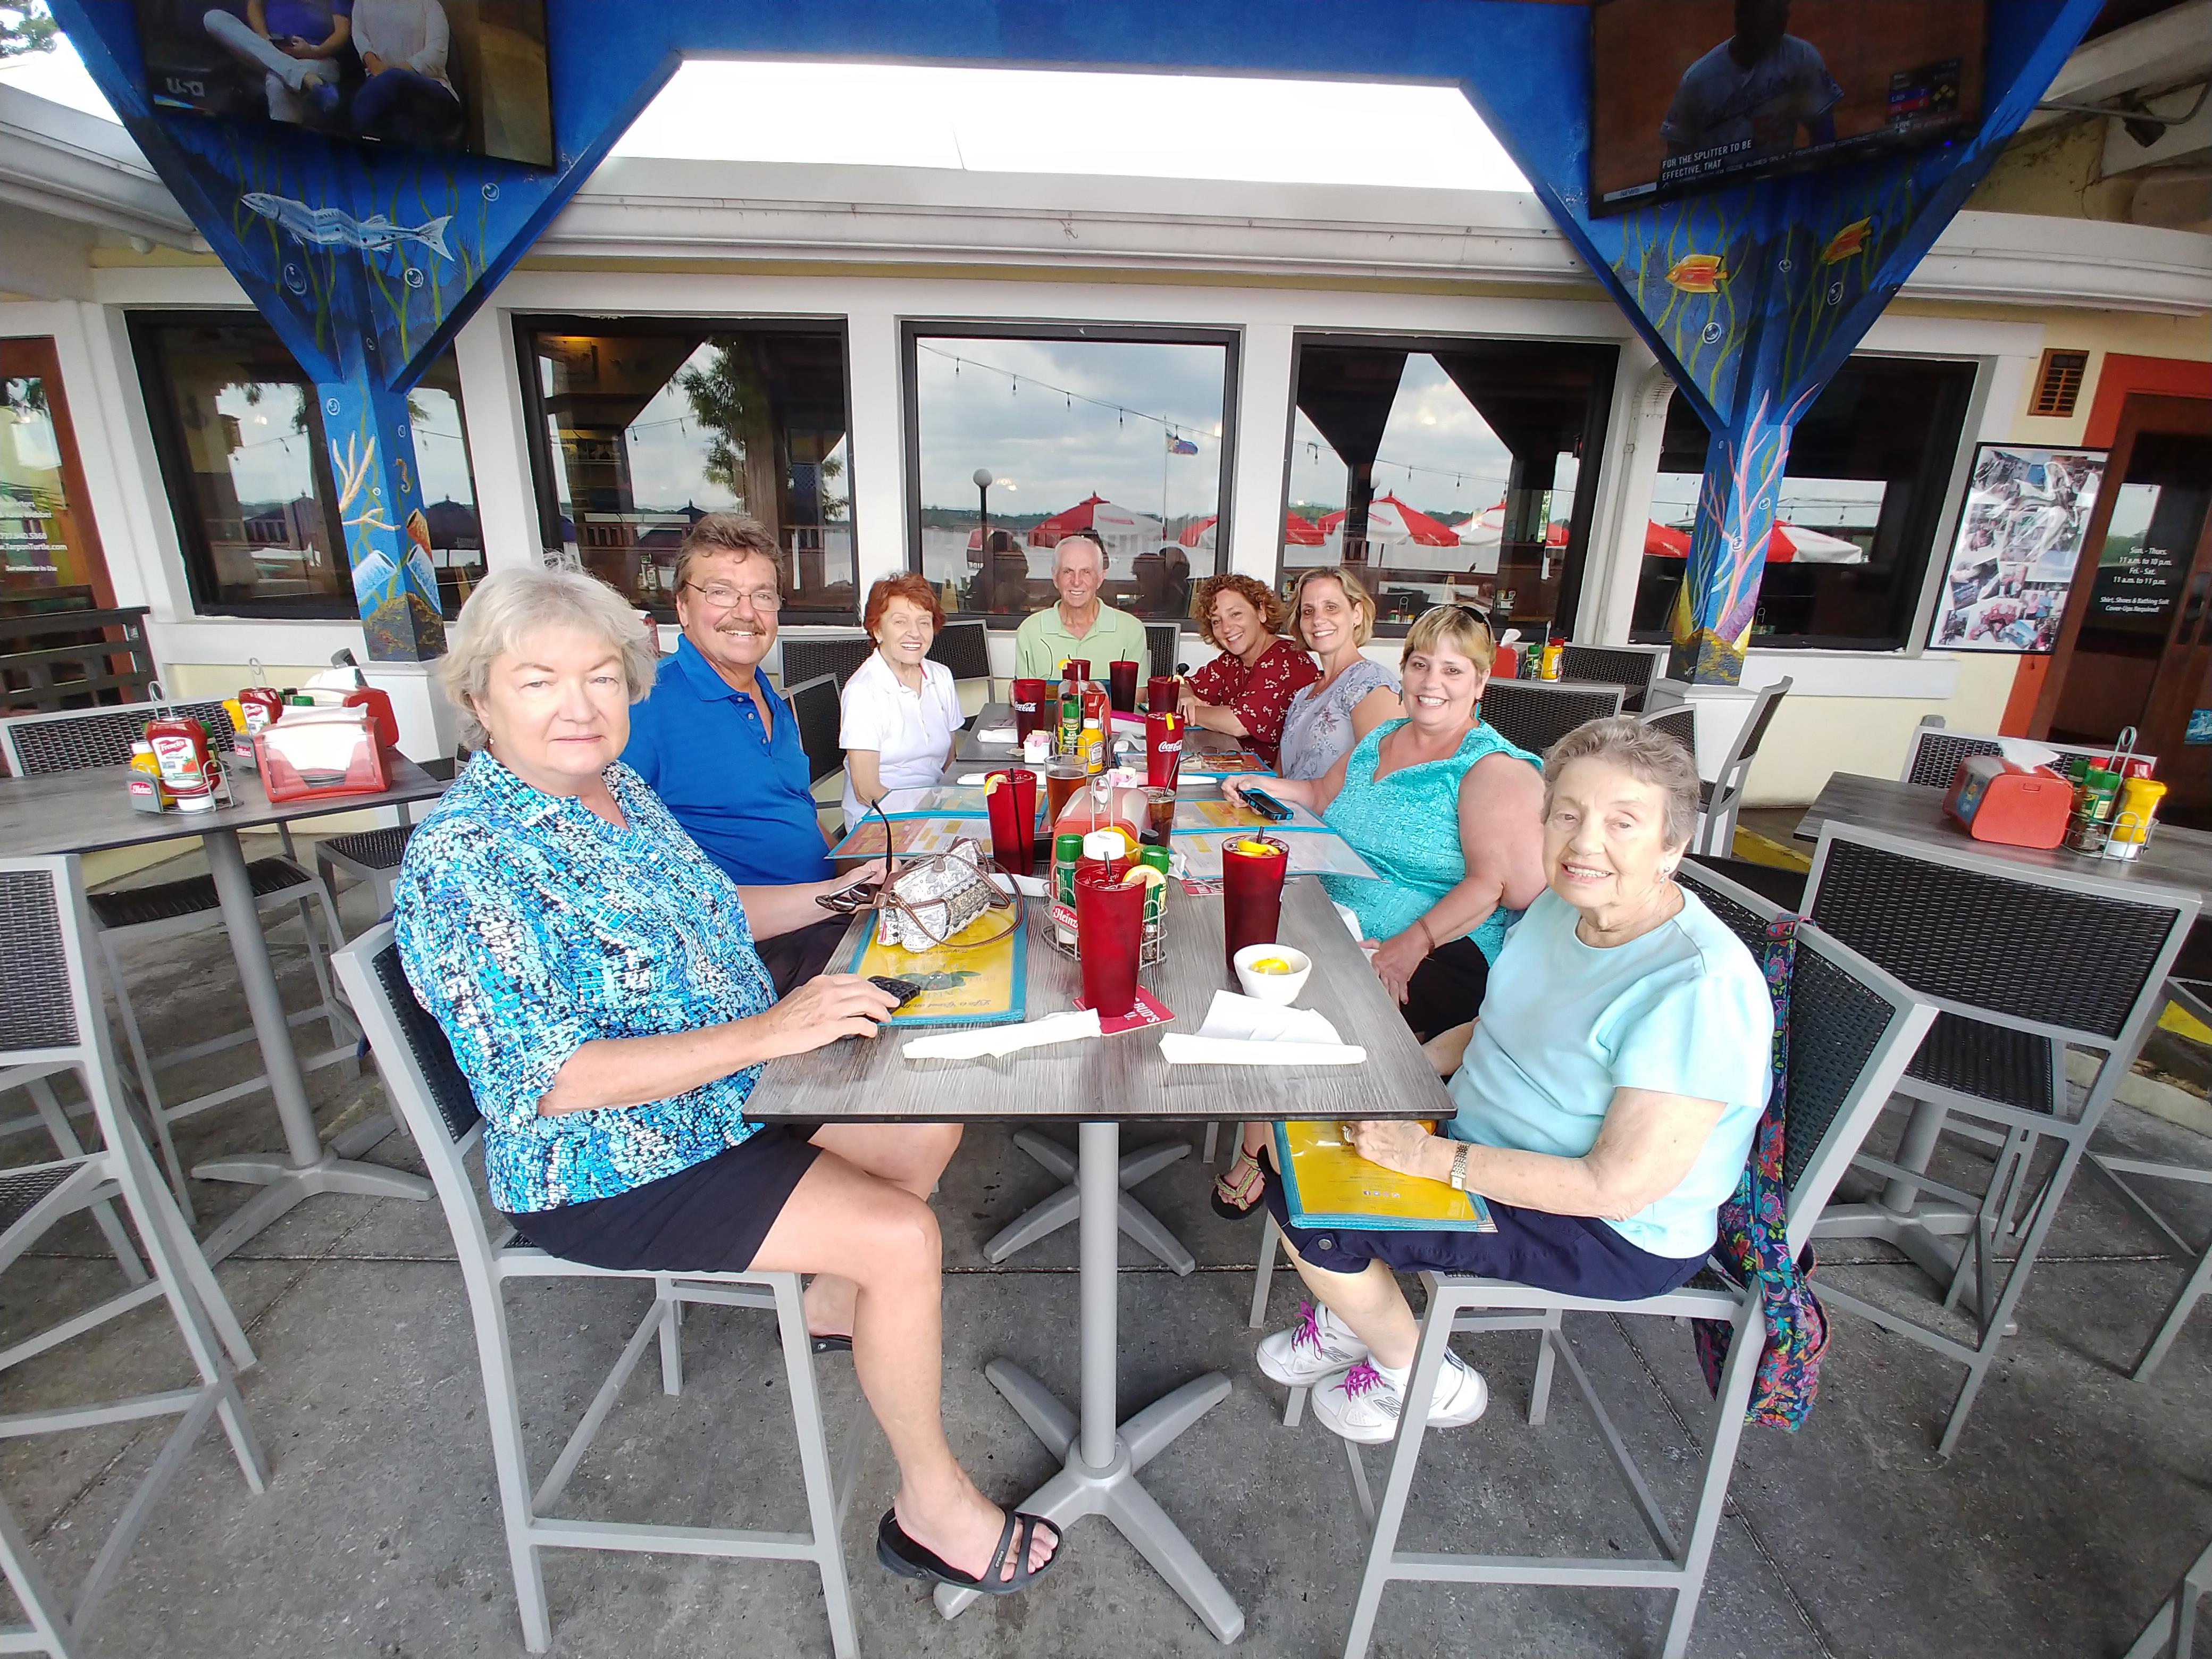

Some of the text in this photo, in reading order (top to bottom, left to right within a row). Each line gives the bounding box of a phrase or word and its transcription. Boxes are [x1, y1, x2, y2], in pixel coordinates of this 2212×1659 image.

[1662, 139, 1752, 169] FOR THE SPLITTER TO BE
[1662, 165, 1702, 181] EFFECTIVE,
[1704, 160, 1722, 171] THAT
[1053, 908, 1078, 928] Heinz
[1134, 1002, 1160, 1023] BUD'S
